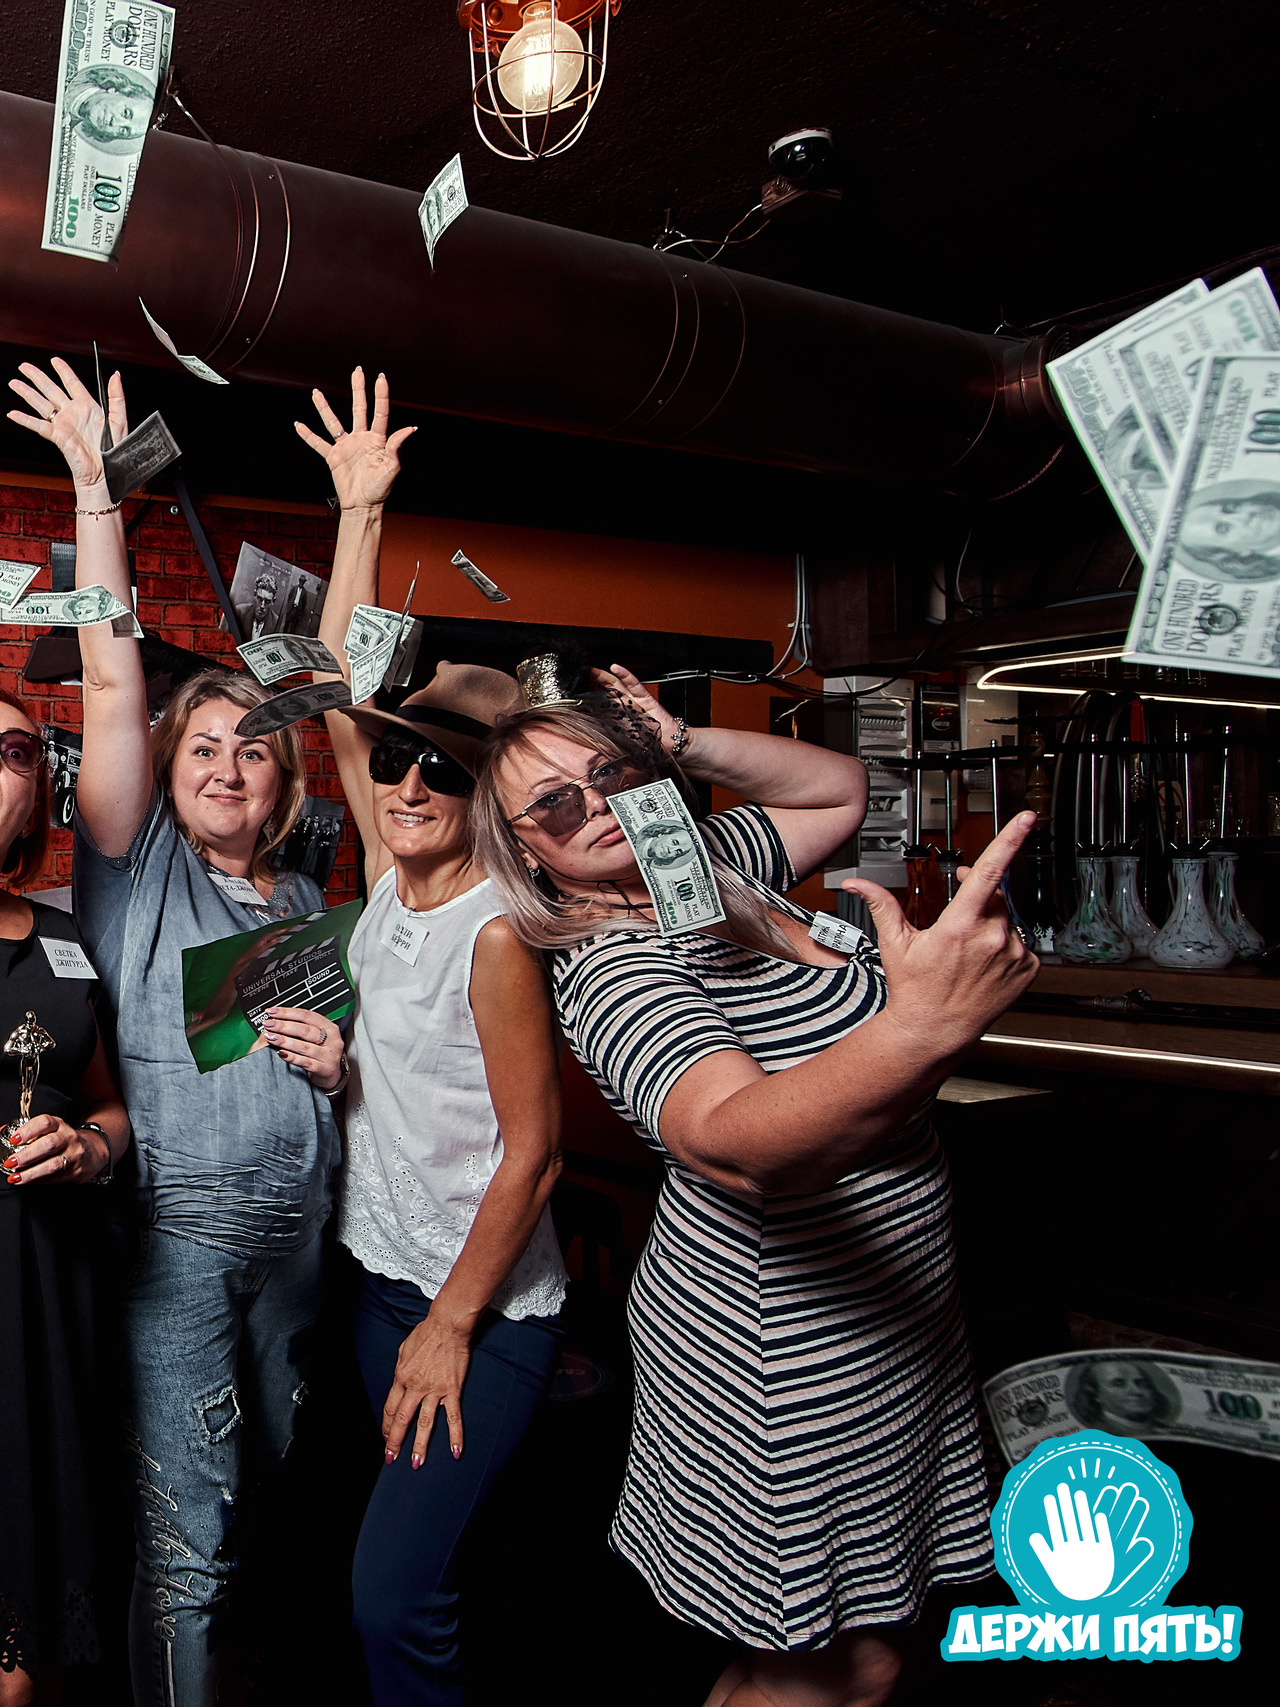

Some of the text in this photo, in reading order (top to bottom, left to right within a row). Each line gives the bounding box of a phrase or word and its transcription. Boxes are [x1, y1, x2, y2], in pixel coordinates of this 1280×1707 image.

[104, 0, 116, 22] PLAY
[140, 9, 158, 71] ONE HUNDRED
[93, 171, 122, 213] 100
[66, 196, 79, 238] 100
[92, 213, 103, 248] MONEY
[105, 221, 115, 246] PLAY
[1, 577, 21, 587] MONEY
[1161, 578, 1200, 650] ONE HUNDRED
[266, 650, 286, 665] 100
[675, 876, 696, 902] 100
[666, 902, 678, 925] 100
[242, 949, 322, 994] UNIVERSAL STUDIOS
[282, 968, 298, 978] TAKE
[308, 969, 330, 985] SOUND
[248, 1008, 262, 1017] DATE
[1203, 1389, 1263, 1420] 100
